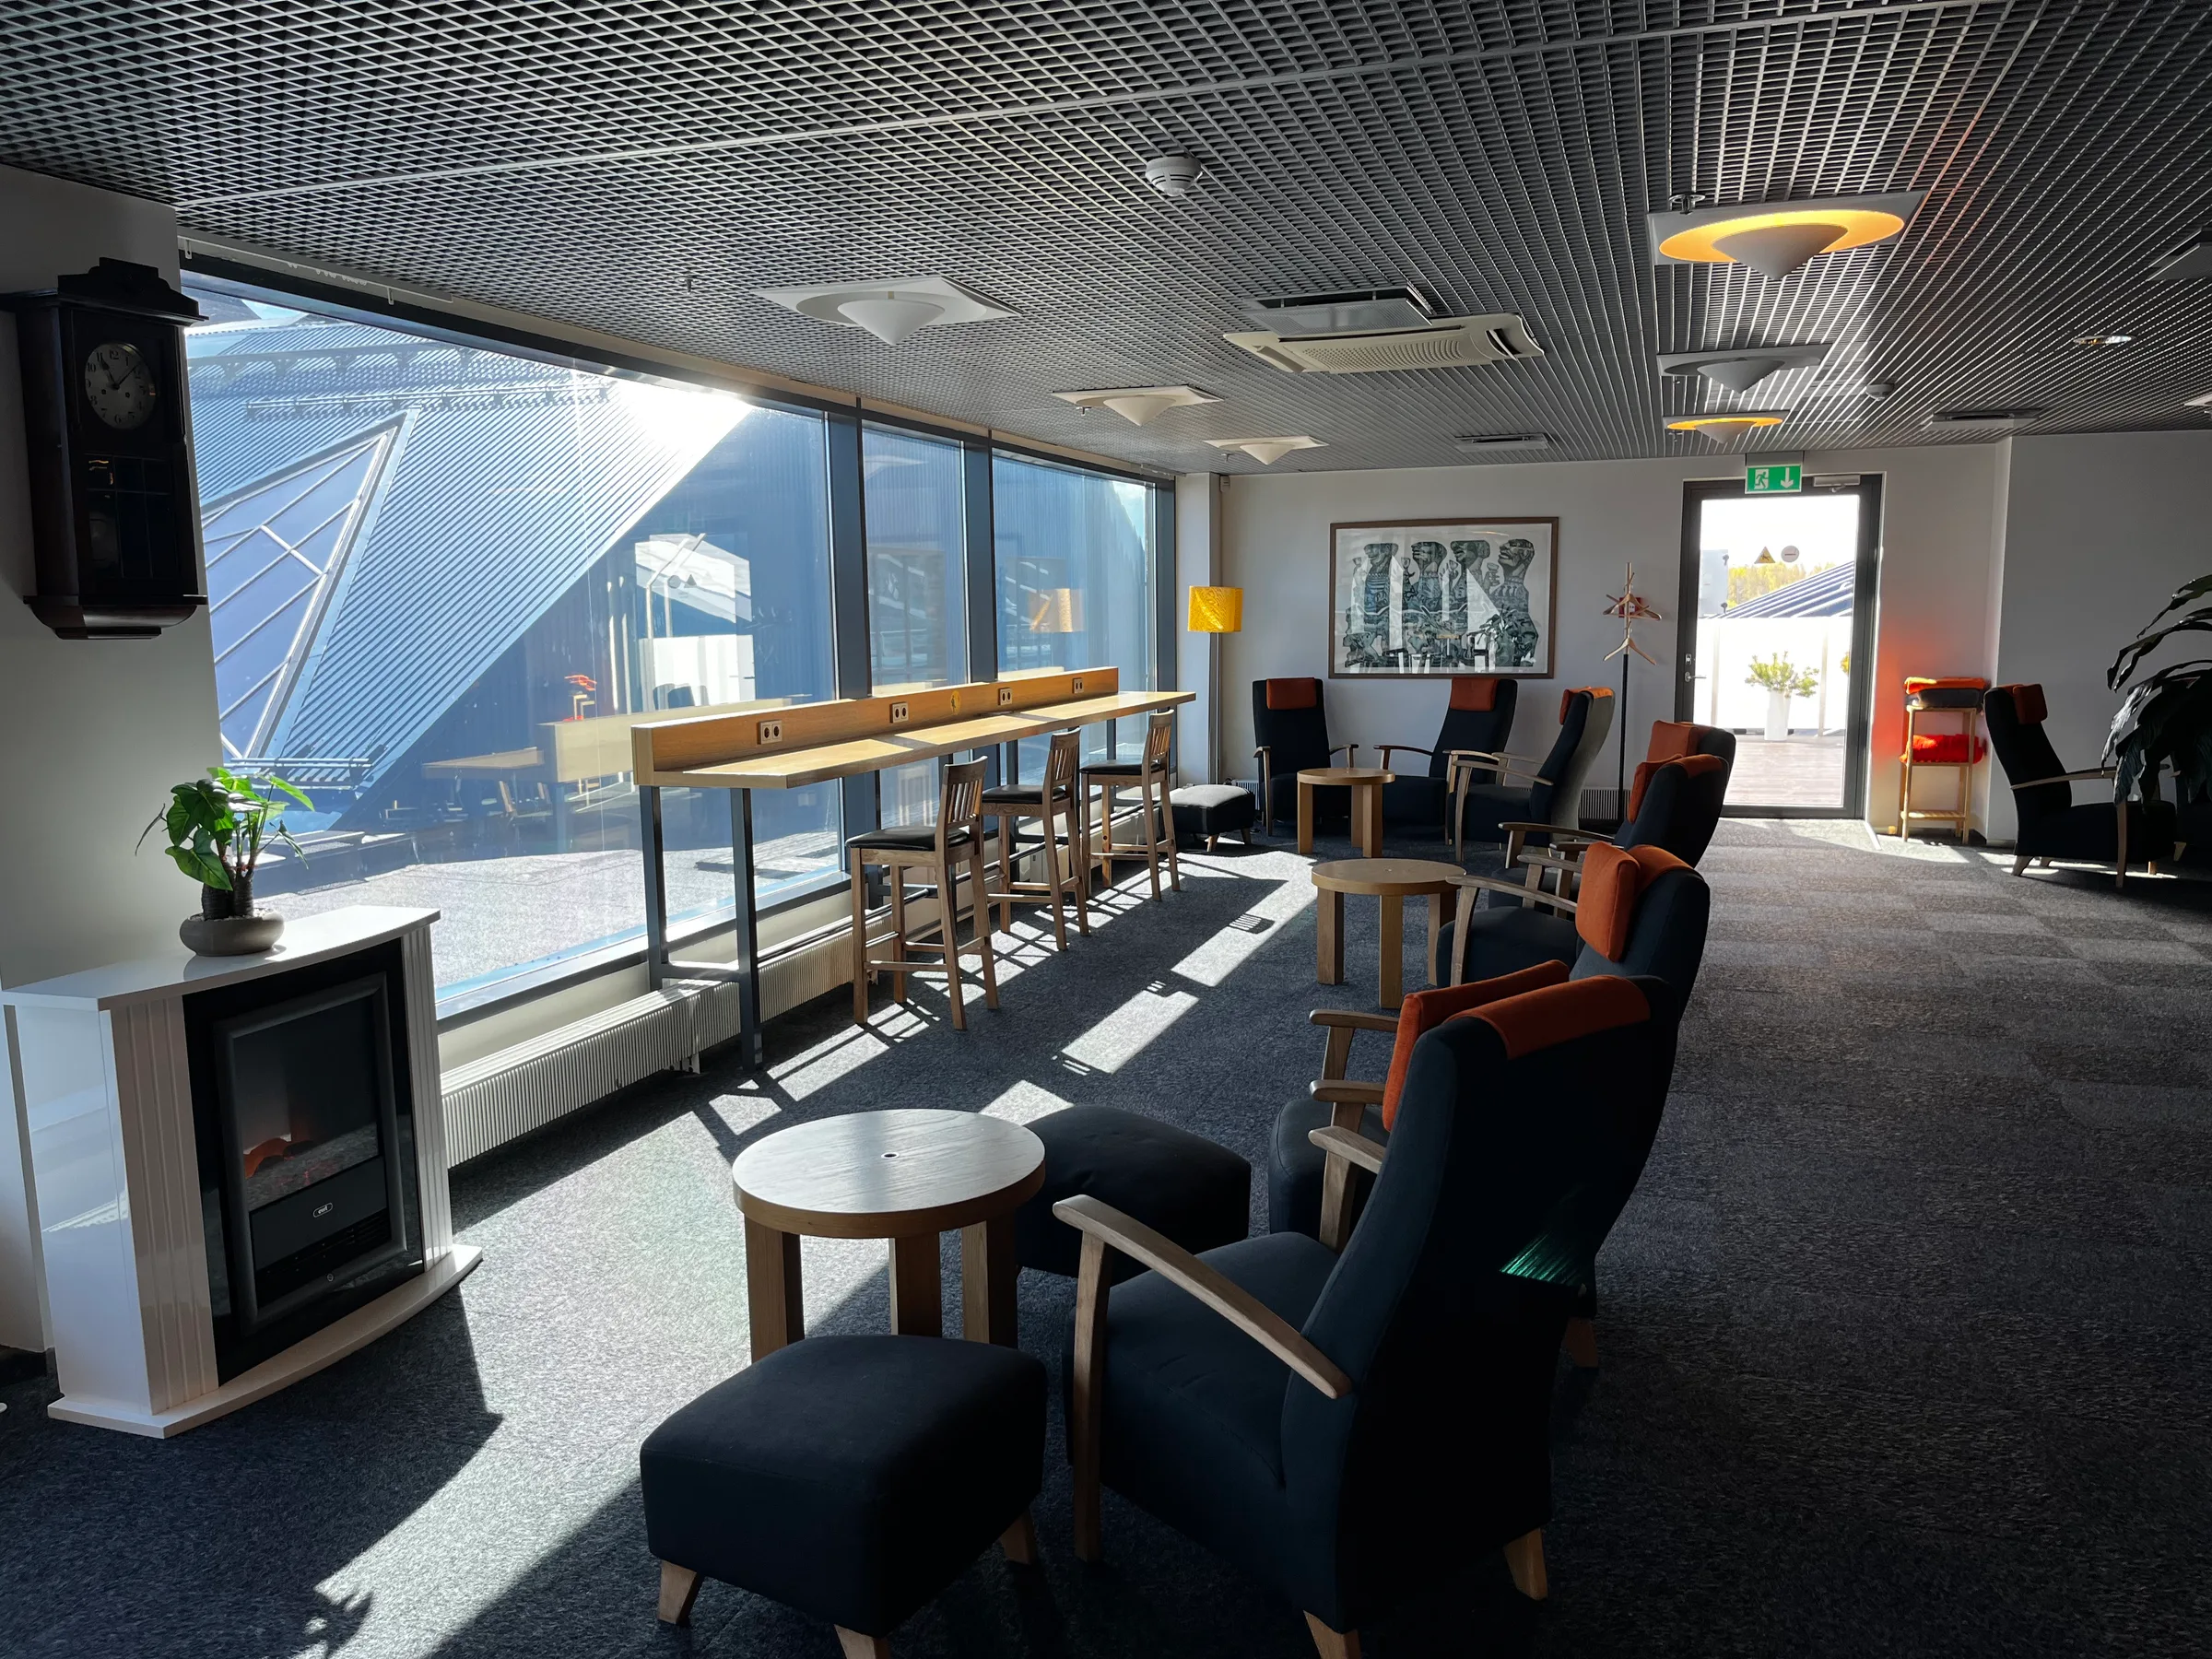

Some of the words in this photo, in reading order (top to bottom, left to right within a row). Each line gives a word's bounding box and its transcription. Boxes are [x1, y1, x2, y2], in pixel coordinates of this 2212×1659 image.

[110, 349, 119, 359] 12
[88, 362, 96, 372] 10
[90, 394, 98, 405] 8
[100, 407, 107, 418] 7
[127, 411, 135, 421] 5
[114, 414, 122, 424] 6
